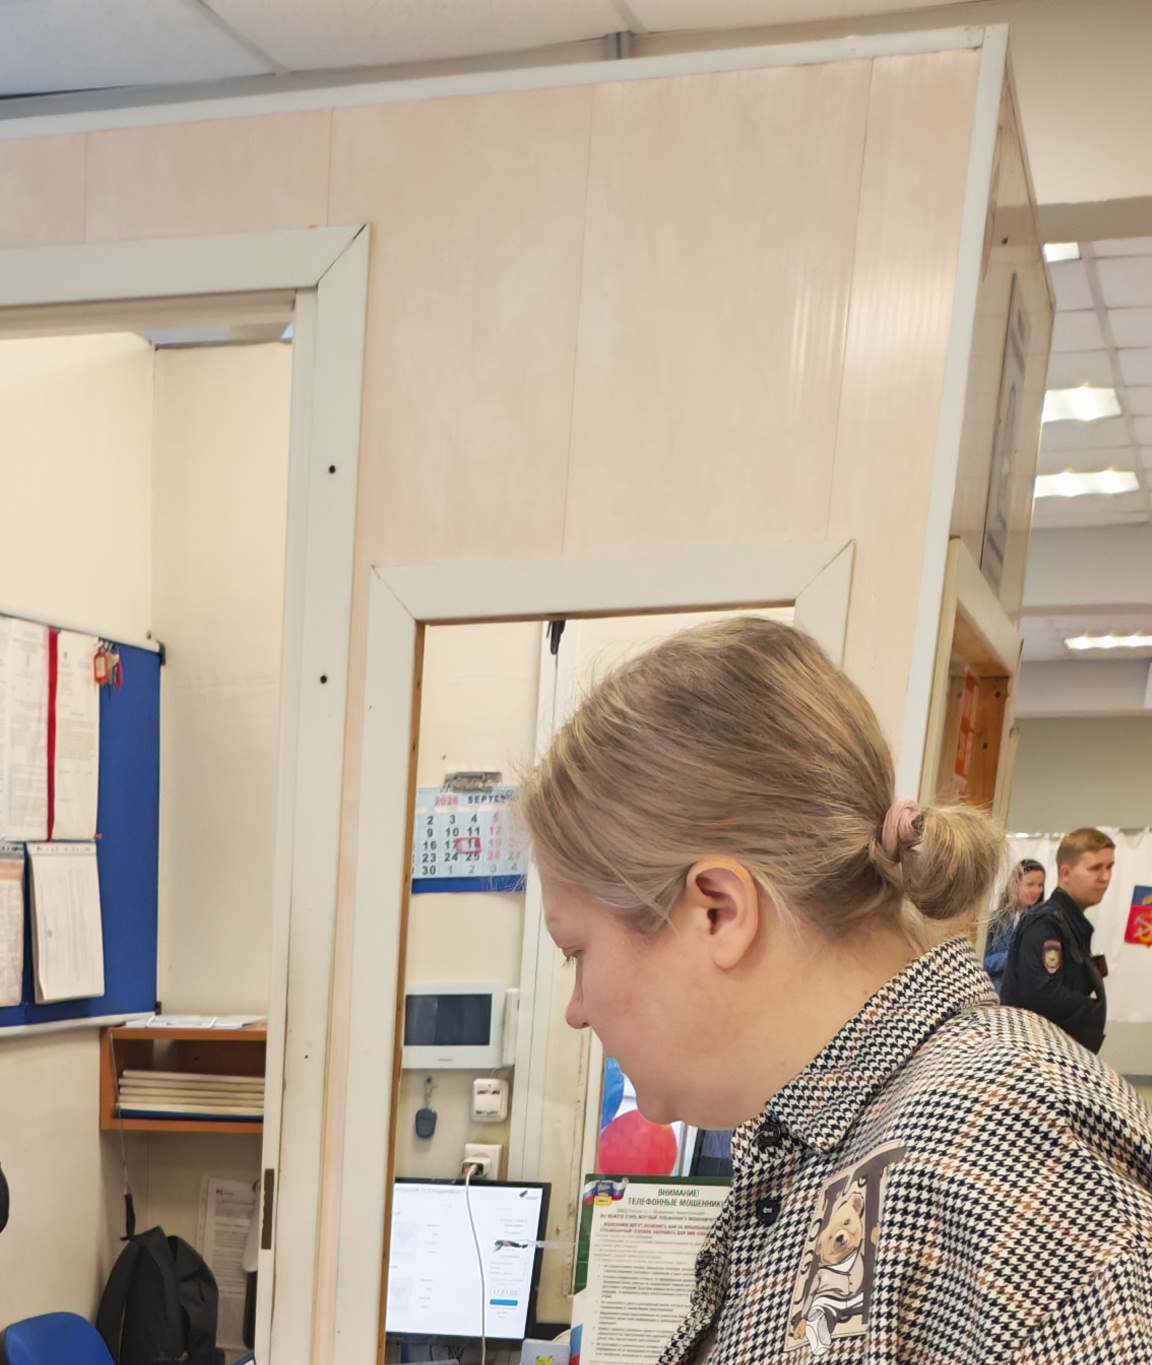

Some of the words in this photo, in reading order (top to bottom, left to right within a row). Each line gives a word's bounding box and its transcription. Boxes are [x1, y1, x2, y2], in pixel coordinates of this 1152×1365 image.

[427, 815, 434, 825] 2
[449, 814, 456, 825] 3
[470, 814, 477, 823] 4
[427, 828, 434, 838] 9
[445, 827, 459, 837] 10
[467, 826, 480, 836] 11
[423, 840, 437, 850] 16
[422, 853, 437, 863] 23
[444, 852, 458, 862] 24
[465, 852, 480, 862] 25
[422, 865, 436, 875] 30
[658, 1188, 700, 1197] ВНИМАНИЕ!
